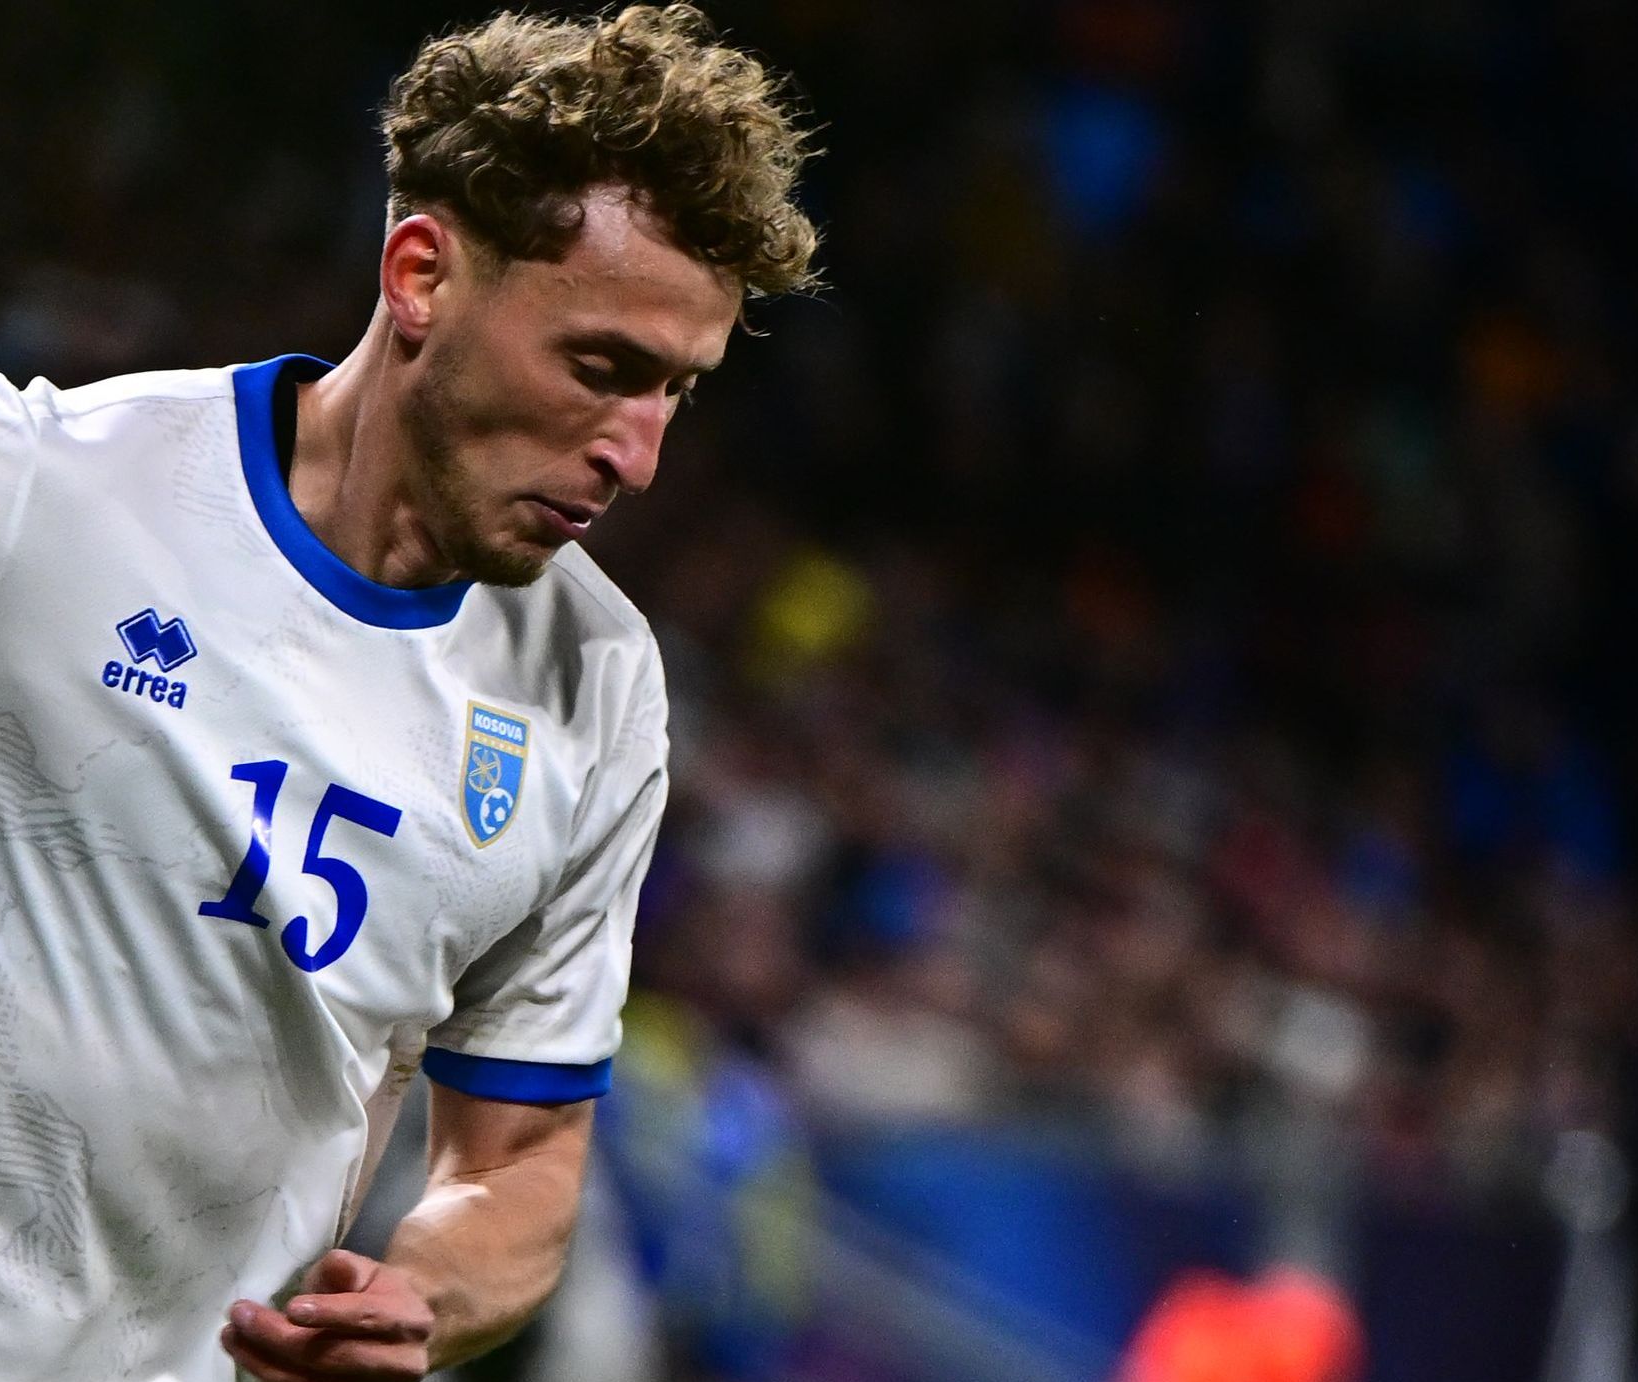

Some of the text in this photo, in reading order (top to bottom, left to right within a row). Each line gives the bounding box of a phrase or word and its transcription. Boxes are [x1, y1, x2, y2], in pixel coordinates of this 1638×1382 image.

[102, 659, 188, 709] errea
[473, 712, 524, 742] KOSOVA
[198, 759, 403, 973] 15
